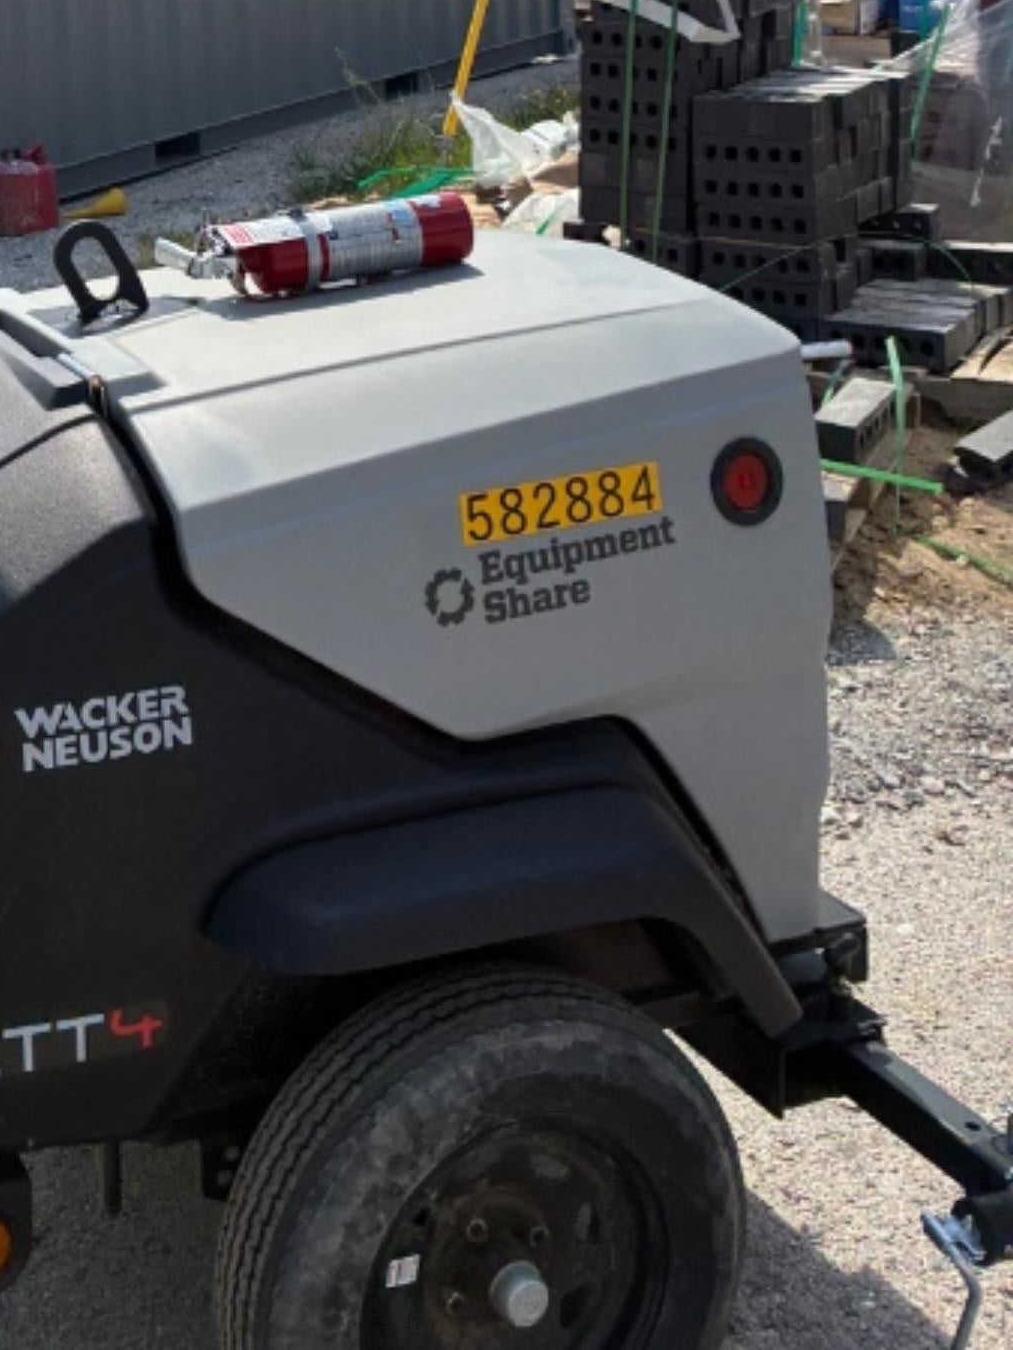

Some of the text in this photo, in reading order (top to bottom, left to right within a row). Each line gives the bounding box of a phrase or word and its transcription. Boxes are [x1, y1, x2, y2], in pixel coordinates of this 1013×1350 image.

[465, 465, 657, 541] 582884
[477, 515, 676, 585] Equipment
[483, 578, 591, 624] Share
[13, 684, 190, 739] WACKER
[22, 716, 193, 772] NEUSON
